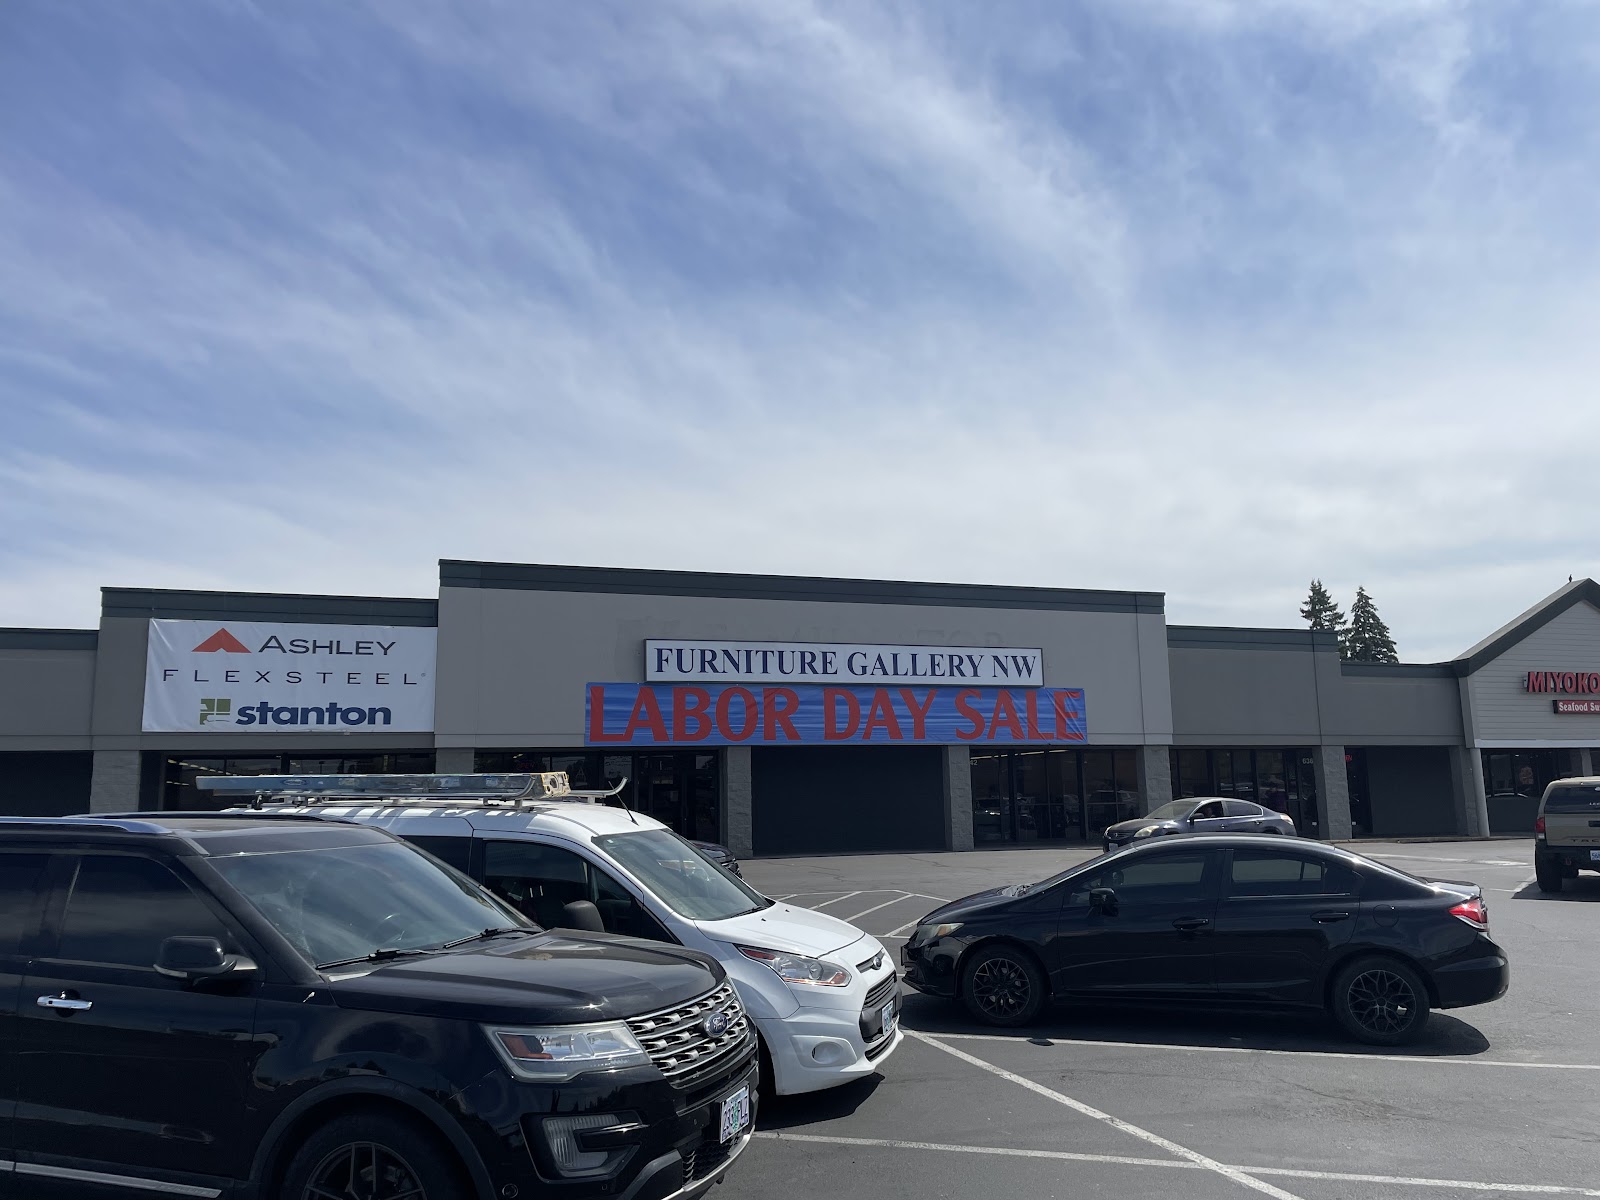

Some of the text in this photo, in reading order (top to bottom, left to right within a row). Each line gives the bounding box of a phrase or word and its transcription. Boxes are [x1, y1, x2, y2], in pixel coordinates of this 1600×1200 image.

[258, 635, 396, 656] ASHLEY
[653, 647, 1038, 679] FURNITURE GALLERY NW
[235, 701, 392, 725] stanton
[588, 685, 1087, 743] LABOR DAY SALE
[1558, 701, 1588, 712] Seafood
